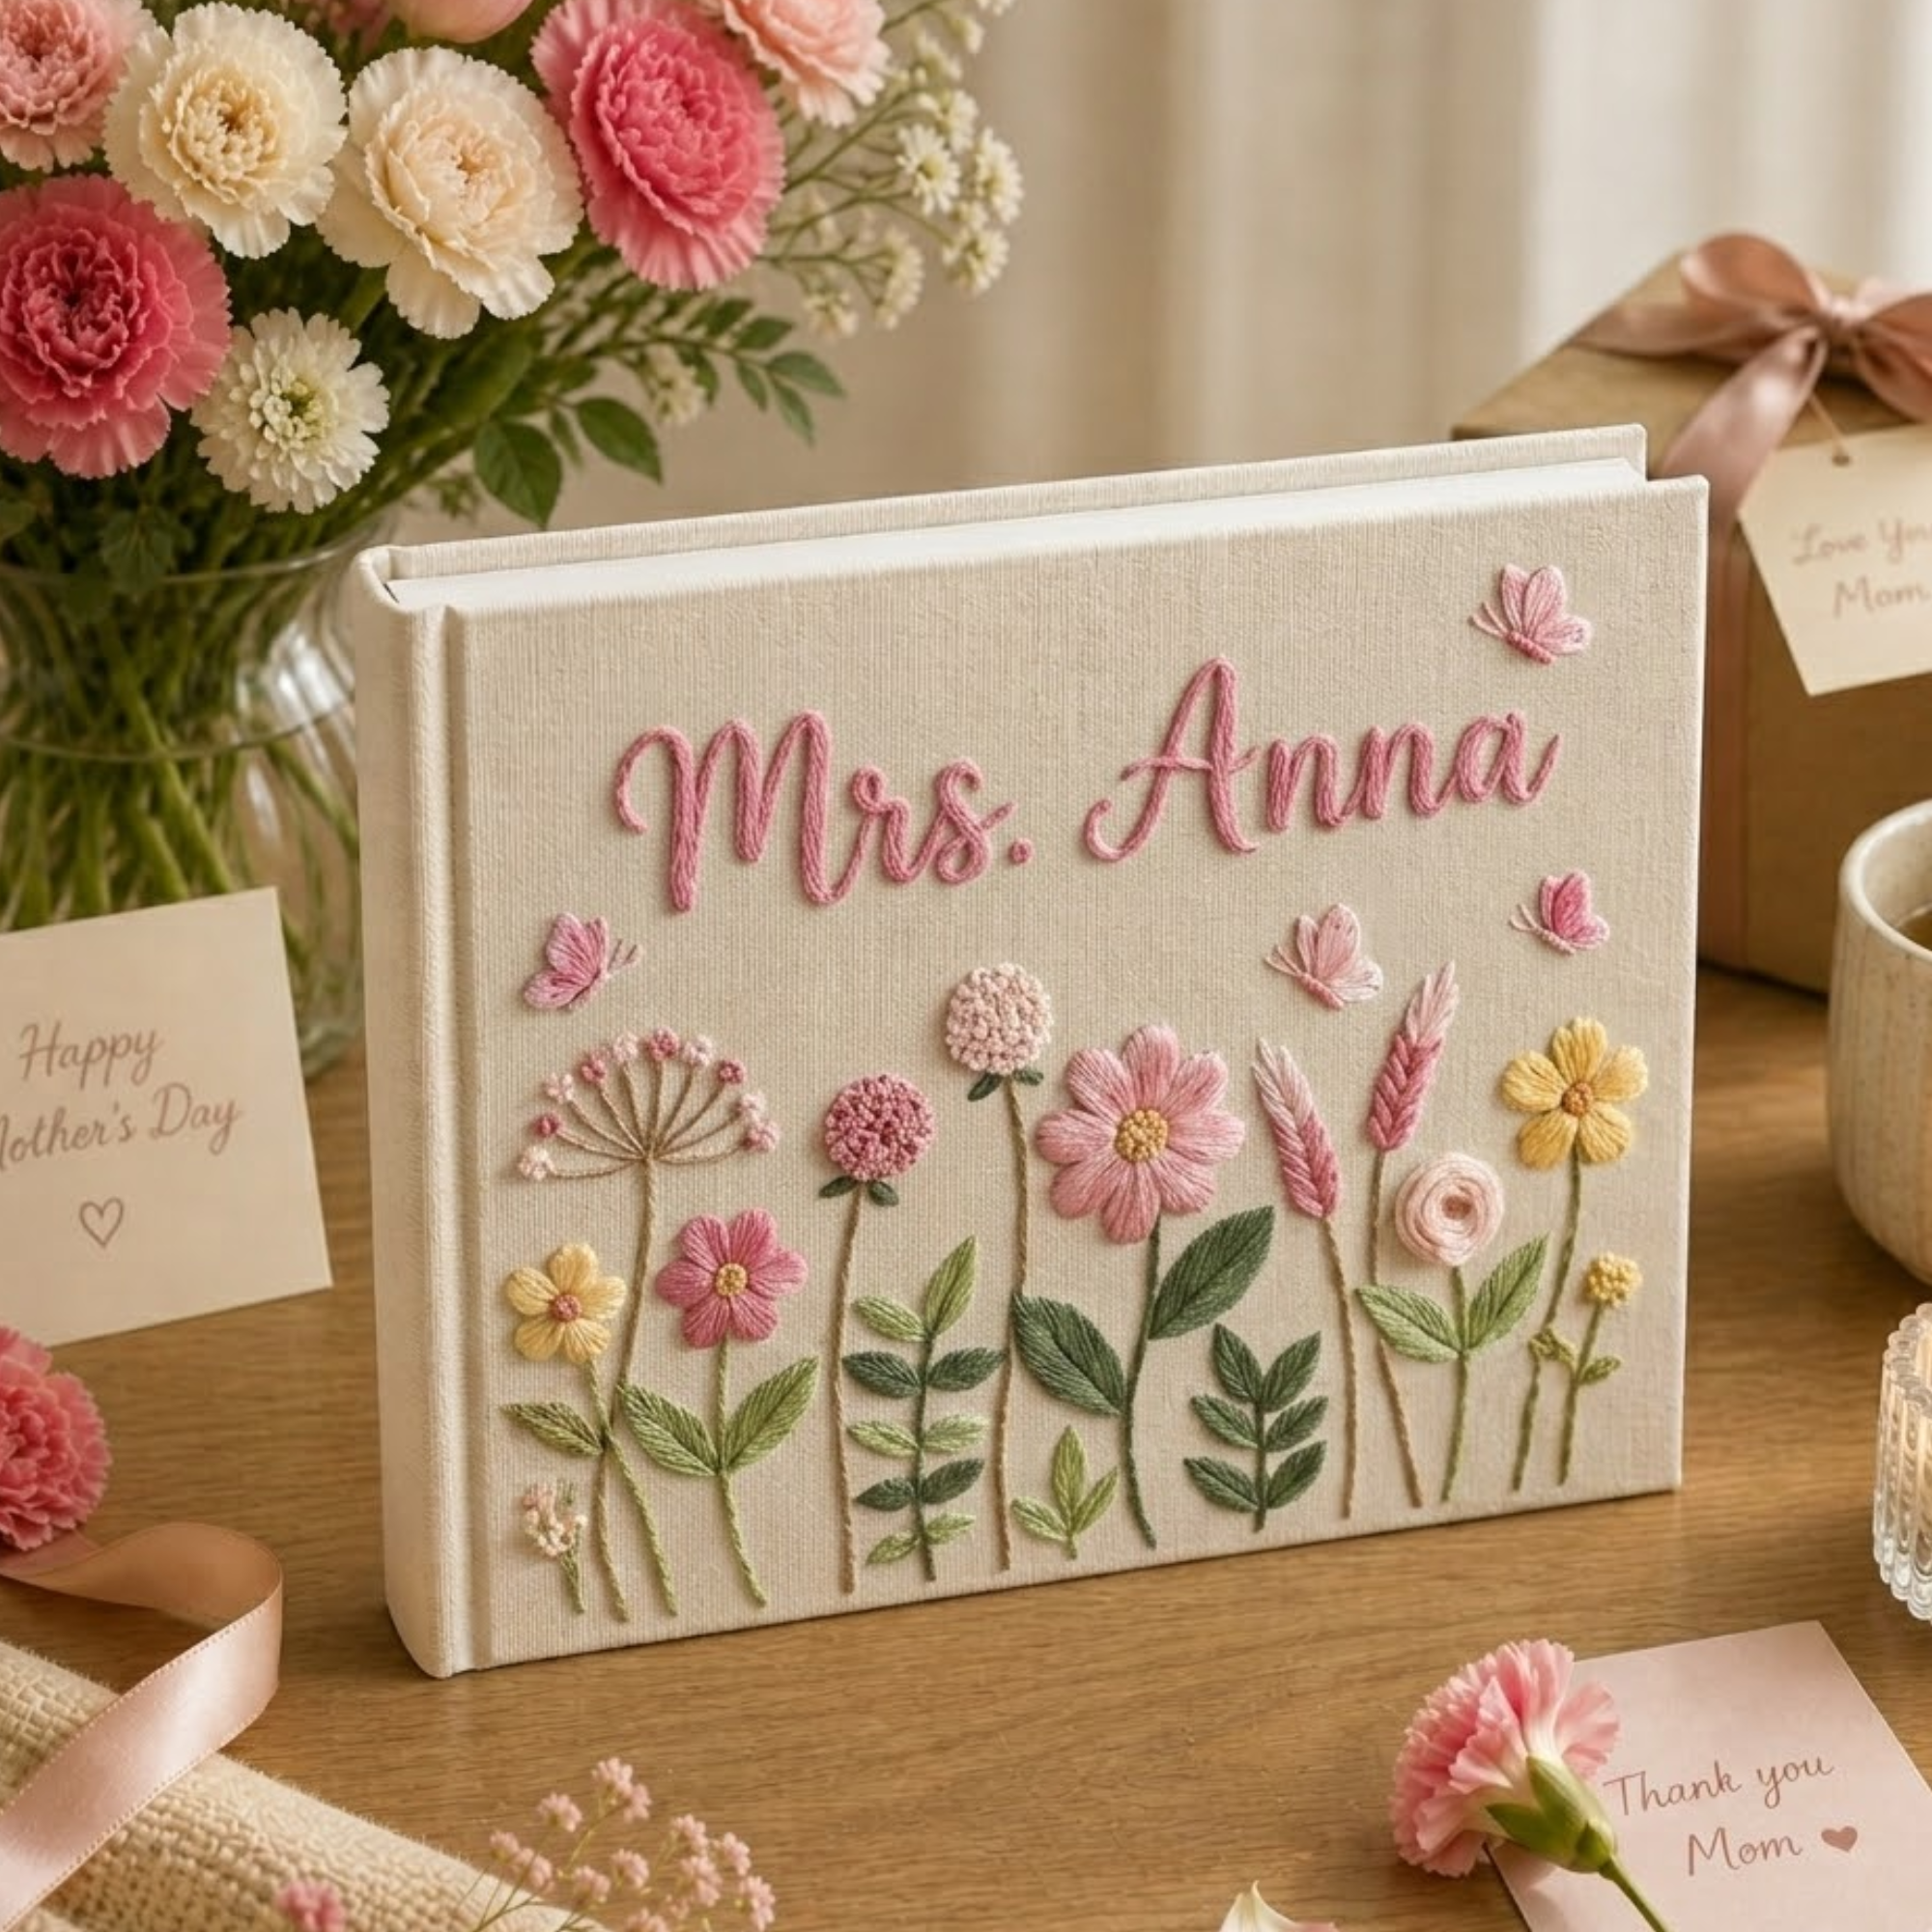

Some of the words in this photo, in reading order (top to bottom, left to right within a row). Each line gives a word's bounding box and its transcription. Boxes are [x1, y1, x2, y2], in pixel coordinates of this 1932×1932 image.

[1792, 523, 1866, 566] Love
[1833, 575, 1930, 620] Mom
[614, 710, 1033, 913] Mrs.
[1083, 657, 1562, 863] Anna
[19, 1021, 161, 1090] Happy
[149, 1082, 242, 1155] Day
[1604, 1761, 1742, 1816] Thank
[1756, 1755, 1833, 1809] you
[1689, 1827, 1803, 1876] Mom
